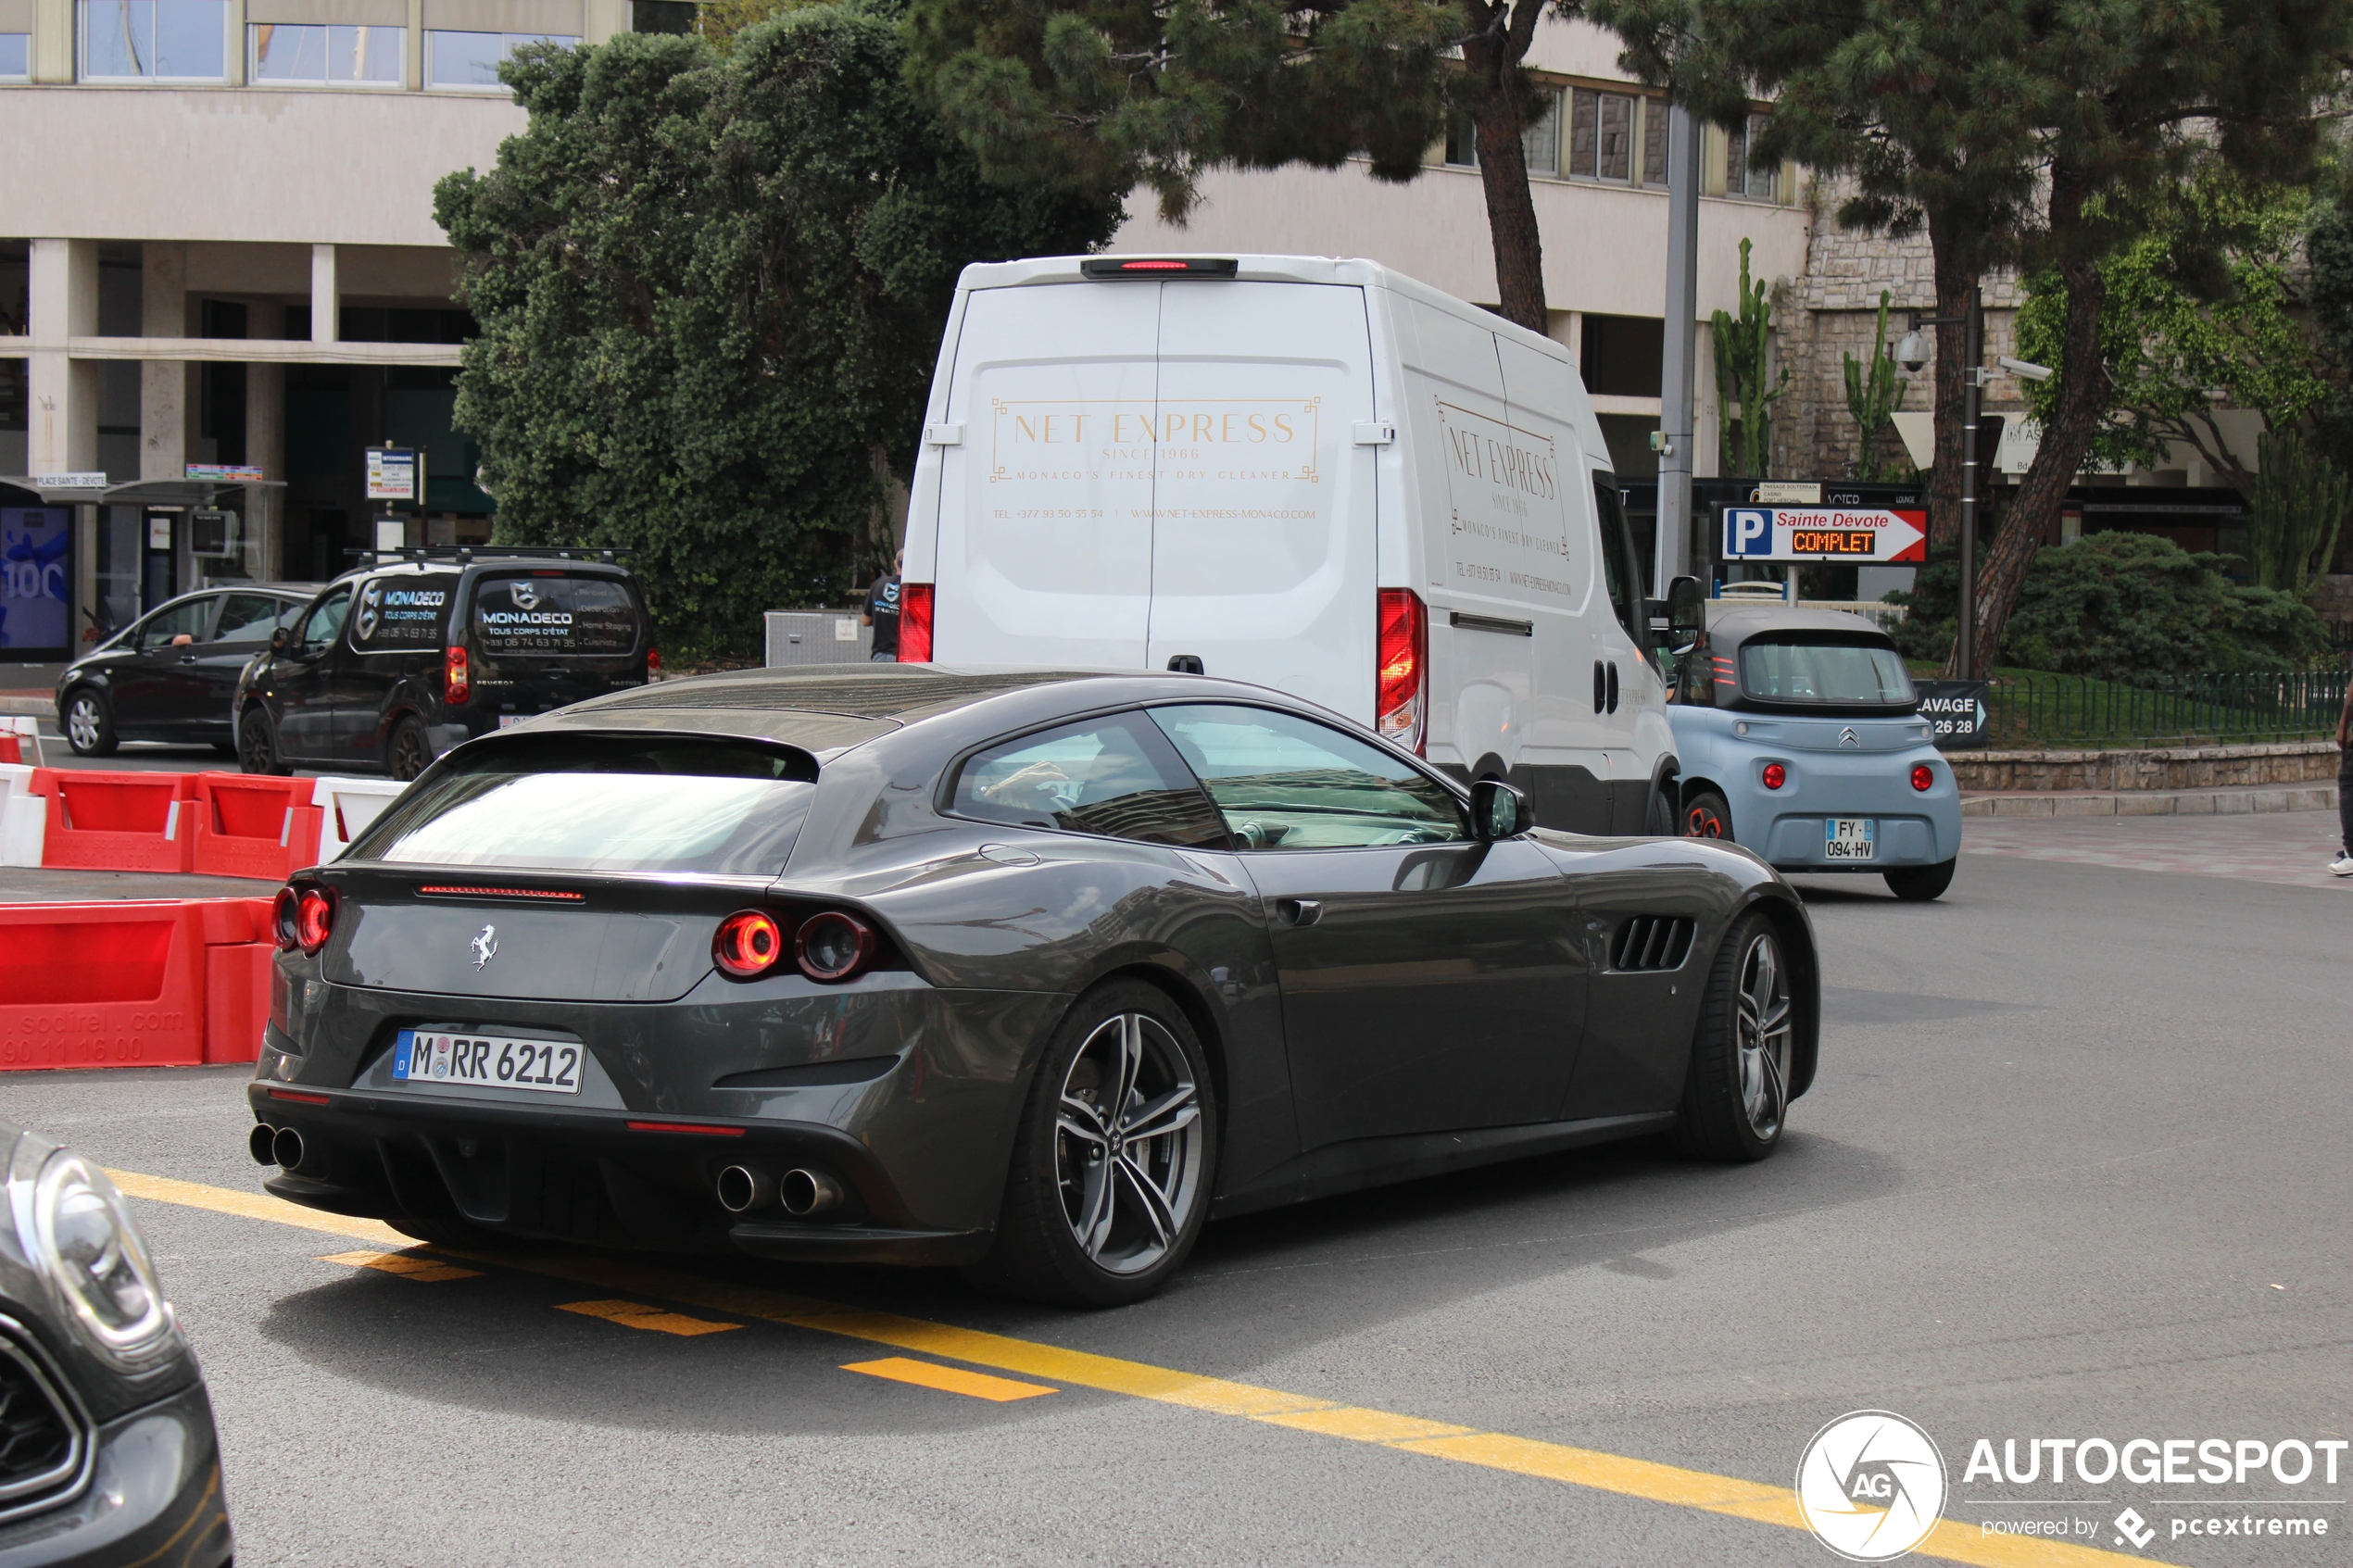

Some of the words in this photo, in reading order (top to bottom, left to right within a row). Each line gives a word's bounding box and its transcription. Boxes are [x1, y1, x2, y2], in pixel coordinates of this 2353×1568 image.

[1015, 414, 1091, 444] NET
[1114, 413, 1294, 445] EXPRESS
[1102, 448, 1151, 460] SINCE
[1161, 447, 1200, 460] 1966
[1450, 427, 1482, 479] NET
[1488, 439, 1554, 500] EXPRESS
[38, 476, 57, 486] PLACE
[57, 476, 78, 485] SAINTE
[82, 474, 106, 485] DÉVOTE
[1016, 470, 1100, 481] MONACO'S
[1110, 470, 1165, 480] FINEST
[1176, 470, 1206, 480] DRY
[1218, 470, 1290, 480] CLEANER
[1491, 493, 1510, 513] SINCE
[1512, 498, 1528, 518] 1966
[1895, 495, 1916, 504] LOUNGE
[1016, 509, 1038, 520] +377
[1042, 510, 1054, 520] 93
[1058, 510, 1072, 519] 50
[1075, 510, 1088, 519] 55
[1090, 510, 1103, 519] 54
[1130, 509, 1316, 520] WWW.NET-EXPRESS-MONACO.COM
[1777, 512, 1827, 527] Sainte
[1832, 512, 1888, 528] Dévote
[1462, 520, 1495, 539] MONACO'S
[1498, 527, 1519, 546] FINEST
[1521, 533, 1533, 548] DRY
[1535, 537, 1561, 555] CLEANER
[1735, 511, 1765, 554] P
[1793, 533, 1873, 552] COMPLET
[384, 591, 445, 607] MONADECO
[384, 610, 398, 620] TOUS
[399, 611, 418, 620] CORPS
[419, 609, 437, 621] D'ÉTAT
[483, 612, 573, 624] MONADECO
[390, 627, 399, 637] 06
[401, 627, 409, 637] 74
[410, 628, 419, 638] 63
[421, 628, 427, 638] 71
[428, 629, 437, 639] 35
[489, 627, 511, 635] TOUS
[542, 626, 569, 635] D'ÉTAT
[583, 621, 603, 630] Home
[605, 621, 632, 633] Staging
[483, 638, 503, 647] (+33)
[505, 638, 519, 646] 06
[522, 638, 534, 646] 74
[536, 638, 549, 646] 63
[553, 638, 560, 646] 71
[563, 639, 575, 647] 35
[584, 637, 617, 646] Cuisiniste
[1917, 697, 1974, 712] AVAGE
[1934, 720, 1953, 734] 26
[1956, 720, 1972, 734] 28
[20, 1008, 108, 1035] sodirel
[131, 1010, 184, 1031] com
[3, 1038, 33, 1063] 90
[42, 1037, 68, 1063] 11
[78, 1037, 107, 1061] 16
[114, 1035, 144, 1060] 00
[411, 1035, 434, 1074] M
[450, 1038, 491, 1080] RR
[497, 1042, 577, 1086] 6212
